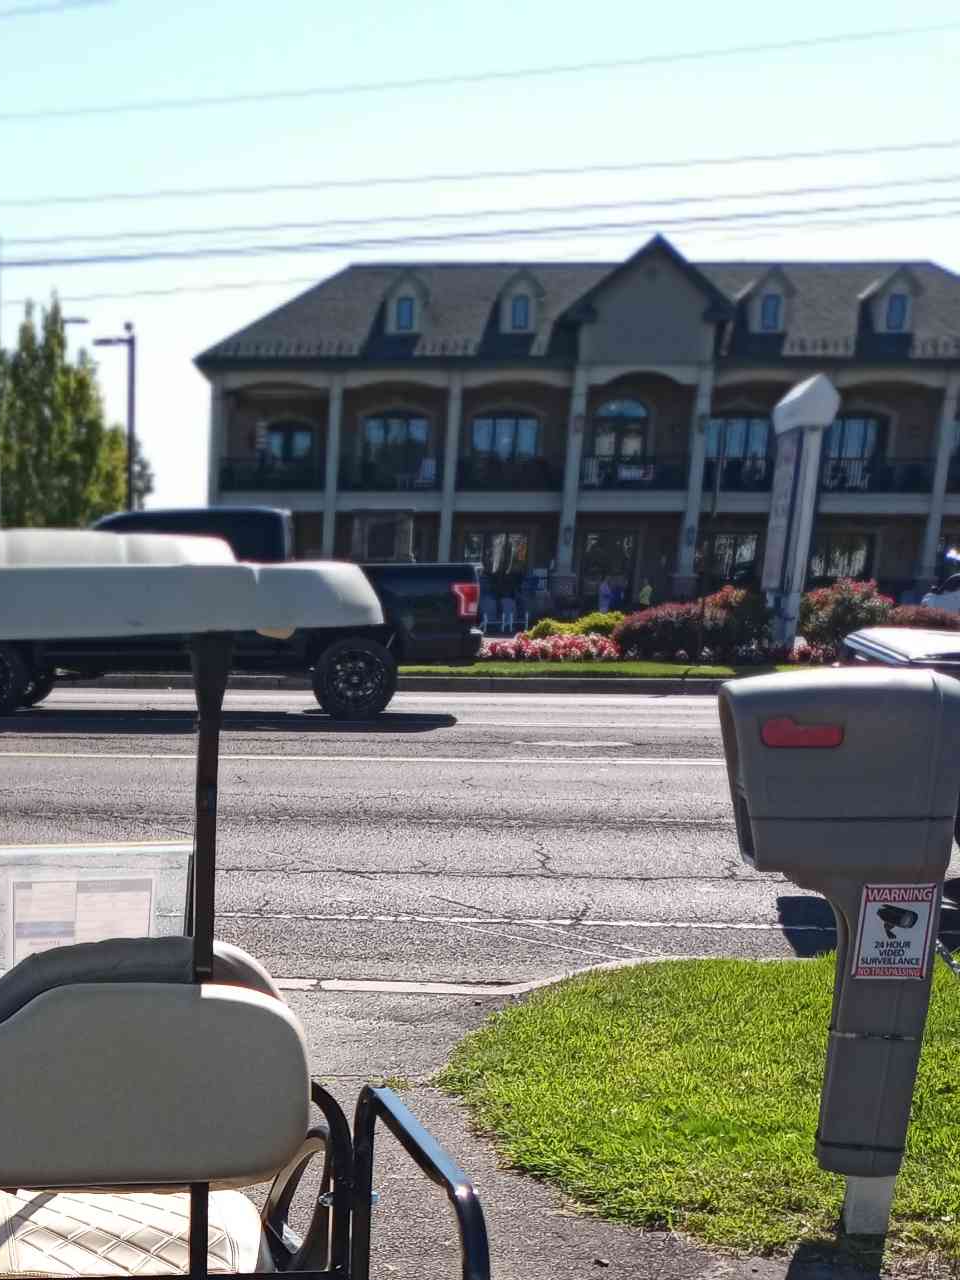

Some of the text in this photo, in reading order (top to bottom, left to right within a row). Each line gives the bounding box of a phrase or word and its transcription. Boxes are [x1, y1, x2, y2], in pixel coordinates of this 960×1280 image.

[868, 888, 933, 900] WARNING
[886, 941, 911, 949] HOUR
[861, 957, 920, 965] SURVEILLANCE
[858, 968, 921, 976] NO TRESPASSING
